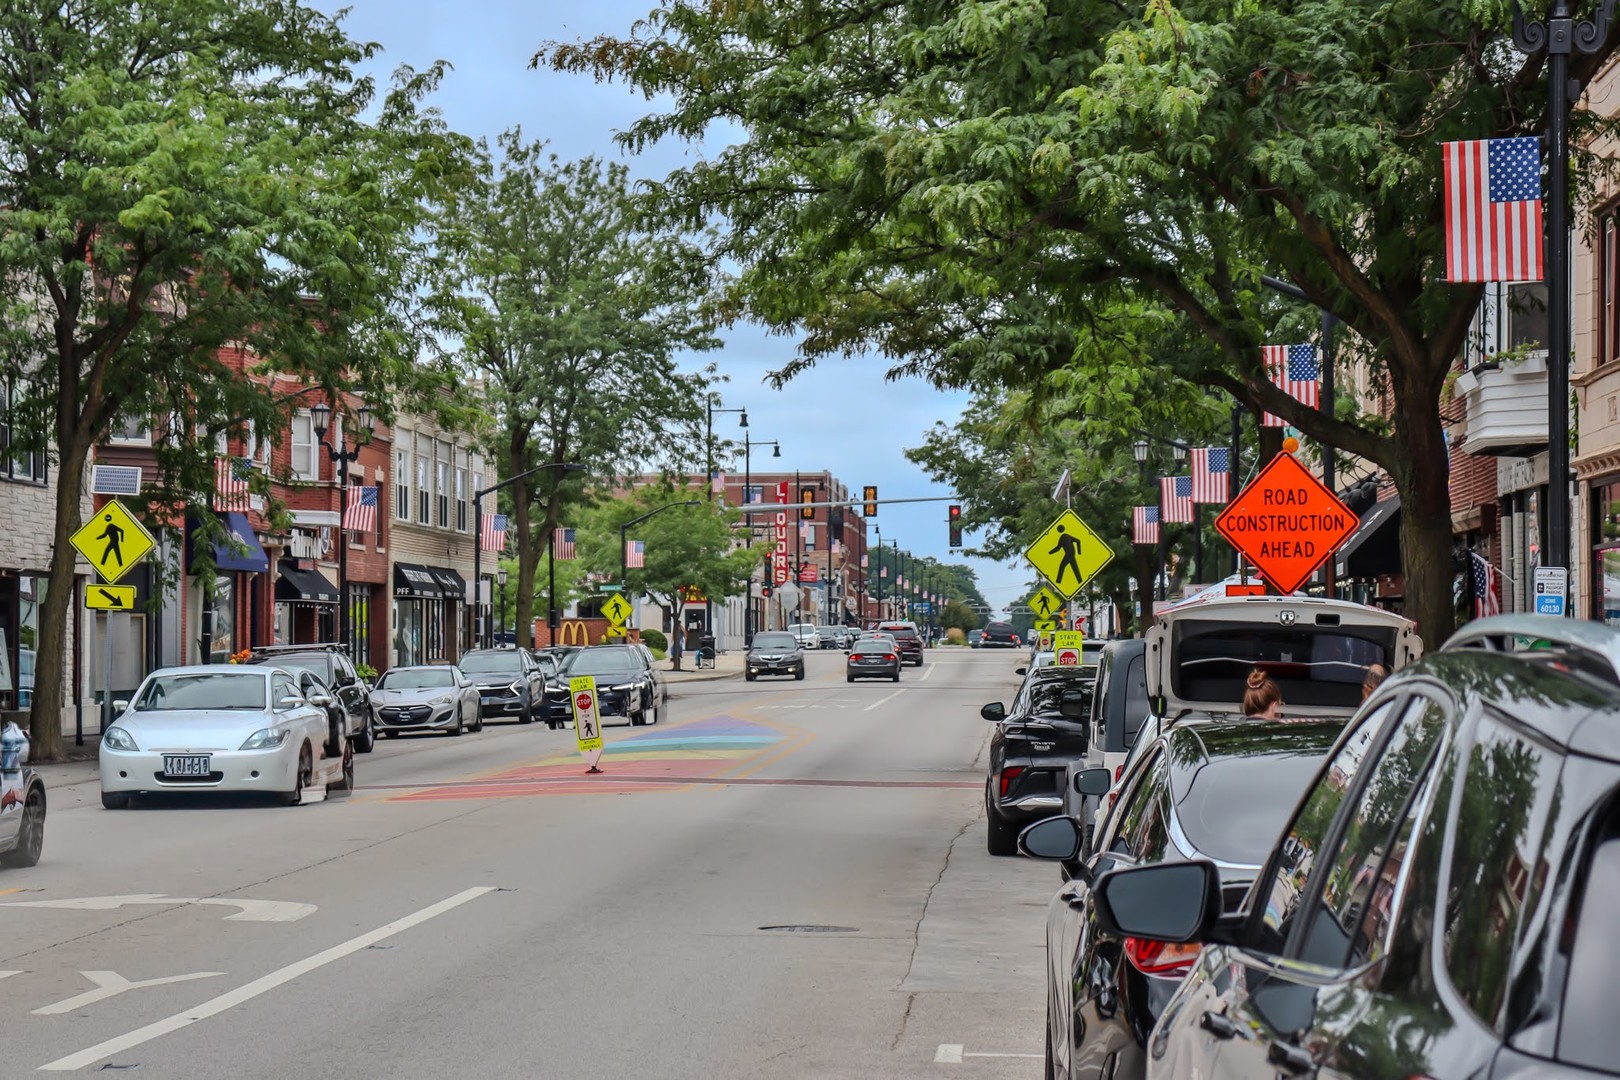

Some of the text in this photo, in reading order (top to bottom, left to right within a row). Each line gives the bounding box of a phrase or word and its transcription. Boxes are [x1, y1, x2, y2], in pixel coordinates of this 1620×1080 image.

[1264, 489, 1308, 505] ROAD
[1226, 515, 1344, 532] CONSTRUCTION
[1260, 541, 1314, 558] AHEAD
[1540, 604, 1560, 613] 60130
[1060, 657, 1077, 665] STOP
[573, 677, 589, 685] STATE
[577, 698, 591, 706] STOP
